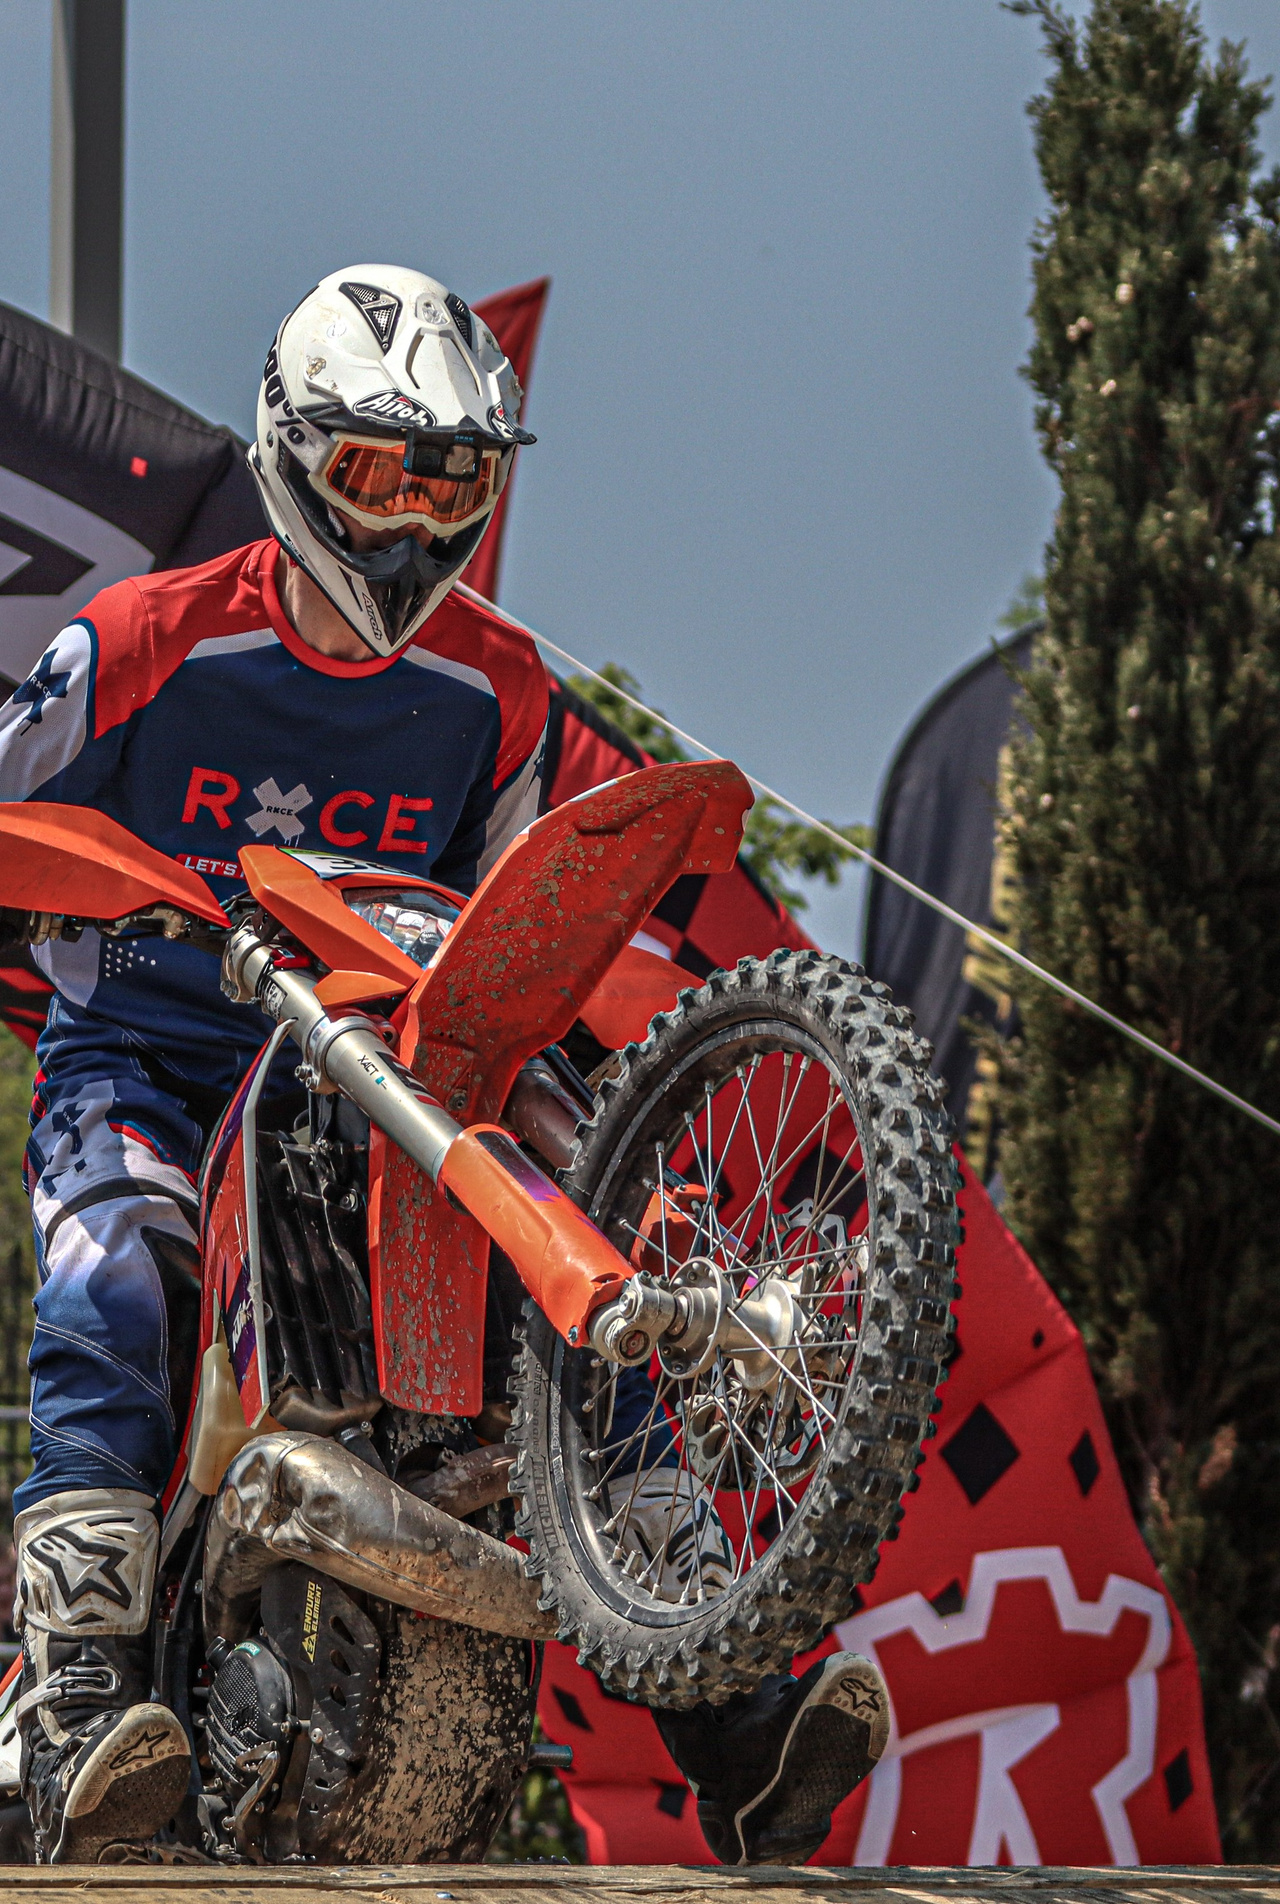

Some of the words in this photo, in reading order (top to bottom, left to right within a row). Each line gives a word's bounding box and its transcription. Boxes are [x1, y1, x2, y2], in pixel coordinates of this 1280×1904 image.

[356, 392, 429, 428] Airoh
[184, 856, 238, 877] LET'S
[357, 1055, 380, 1077] XACT
[532, 1463, 559, 1549] MICHELIN
[303, 1581, 315, 1633] ENDURO
[312, 1584, 322, 1632] ELEMENT
